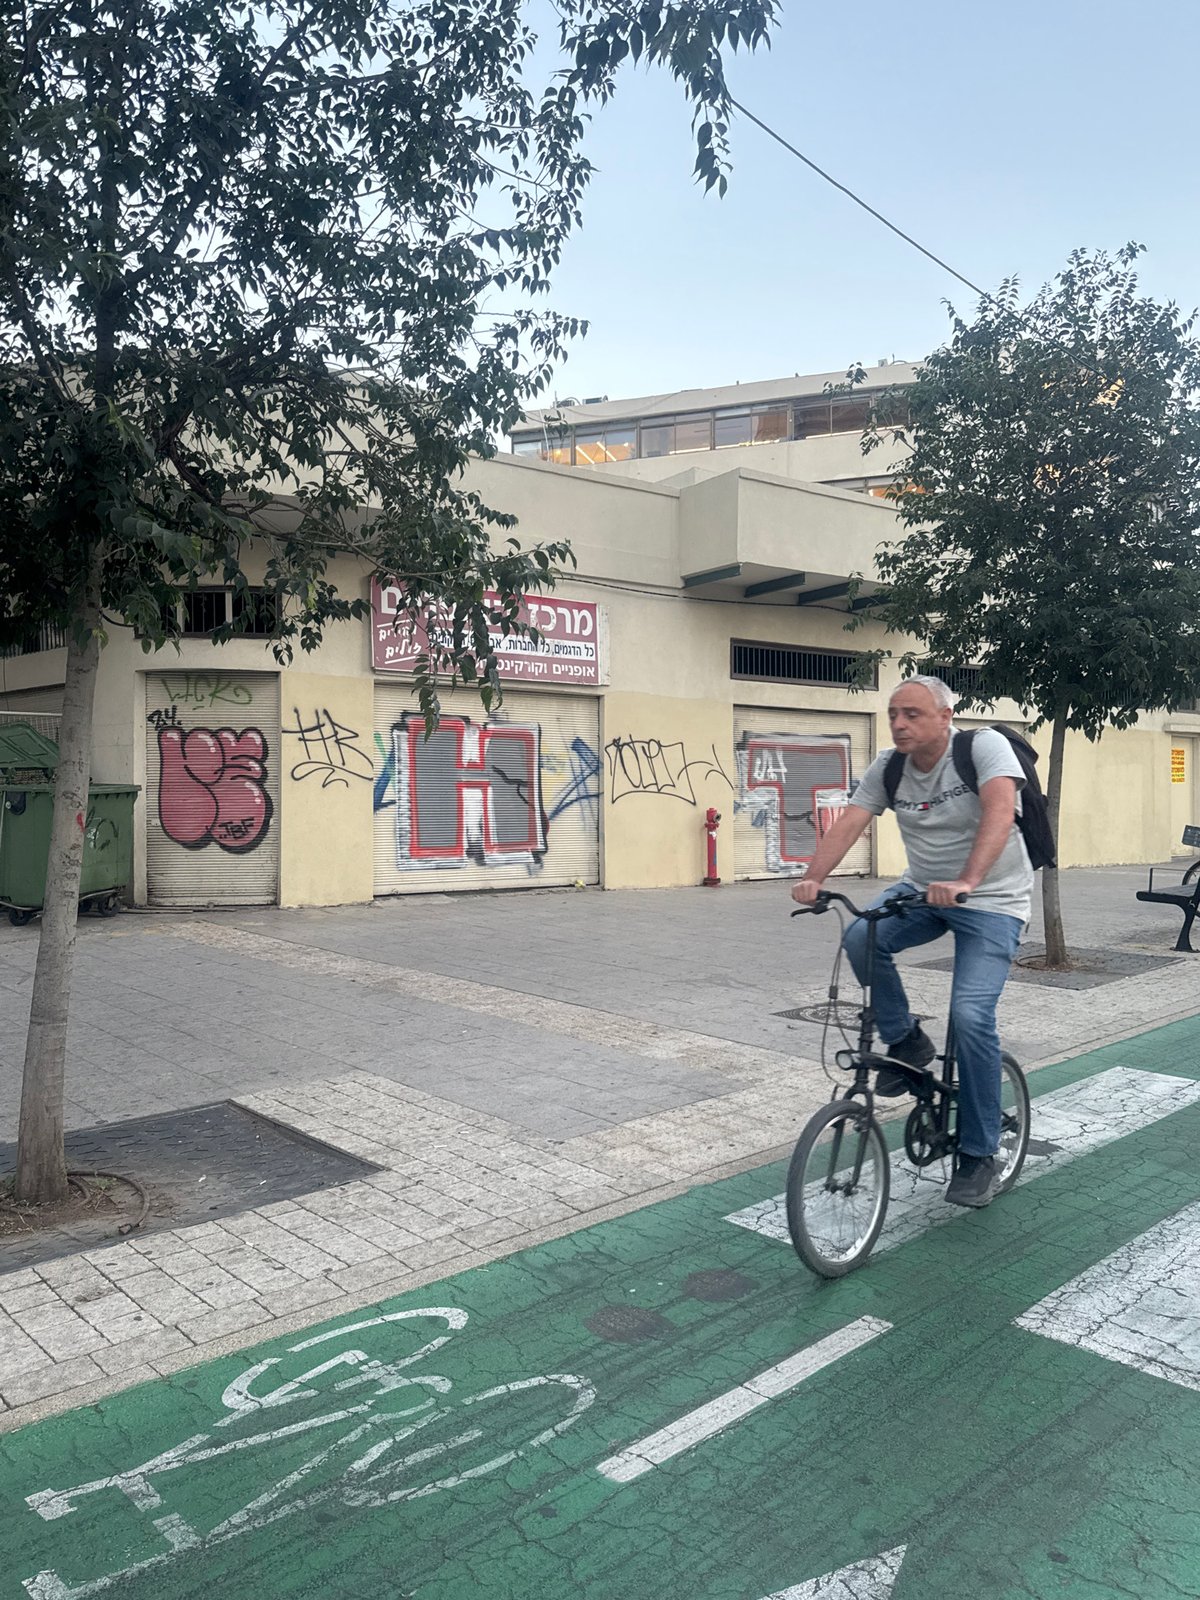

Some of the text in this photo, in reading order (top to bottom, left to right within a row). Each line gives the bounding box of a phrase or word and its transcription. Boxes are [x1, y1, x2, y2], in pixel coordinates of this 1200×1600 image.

[527, 603, 594, 636] מרכז
[584, 644, 594, 657] כל
[552, 663, 595, 677] אופניים
[929, 783, 971, 808] HILFIGE
